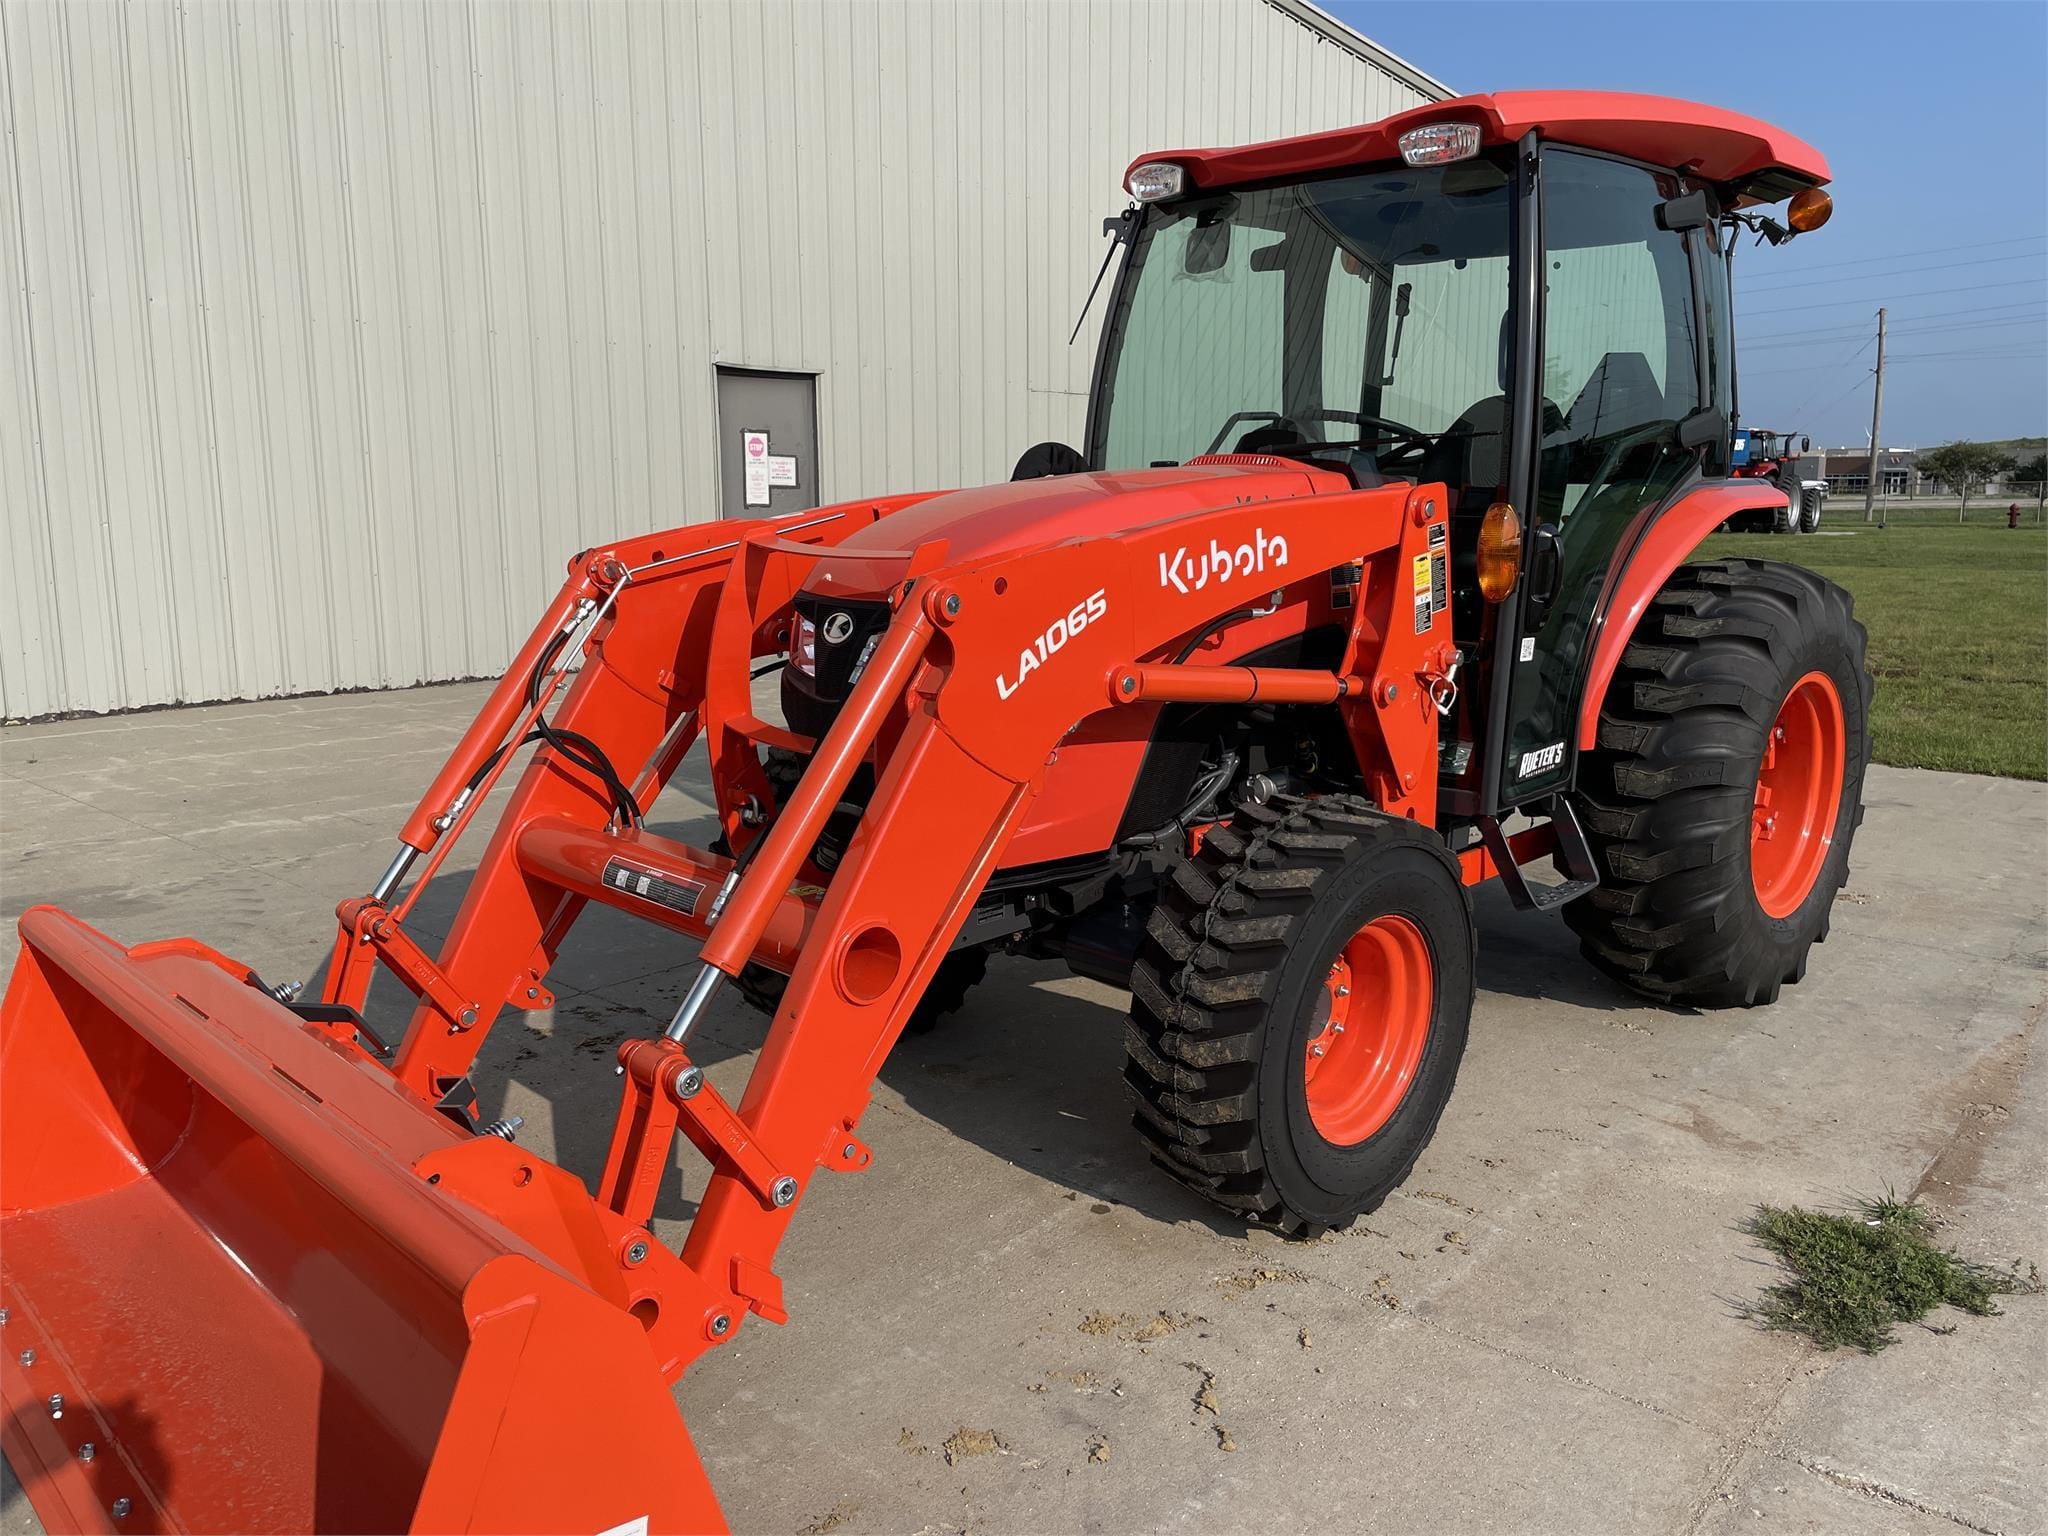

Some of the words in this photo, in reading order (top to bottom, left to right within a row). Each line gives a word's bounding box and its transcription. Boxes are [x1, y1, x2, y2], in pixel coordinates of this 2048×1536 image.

[1159, 527, 1288, 594] Kubota
[995, 587, 1107, 701] LA1065
[1518, 741, 1565, 778] RUETER'S
